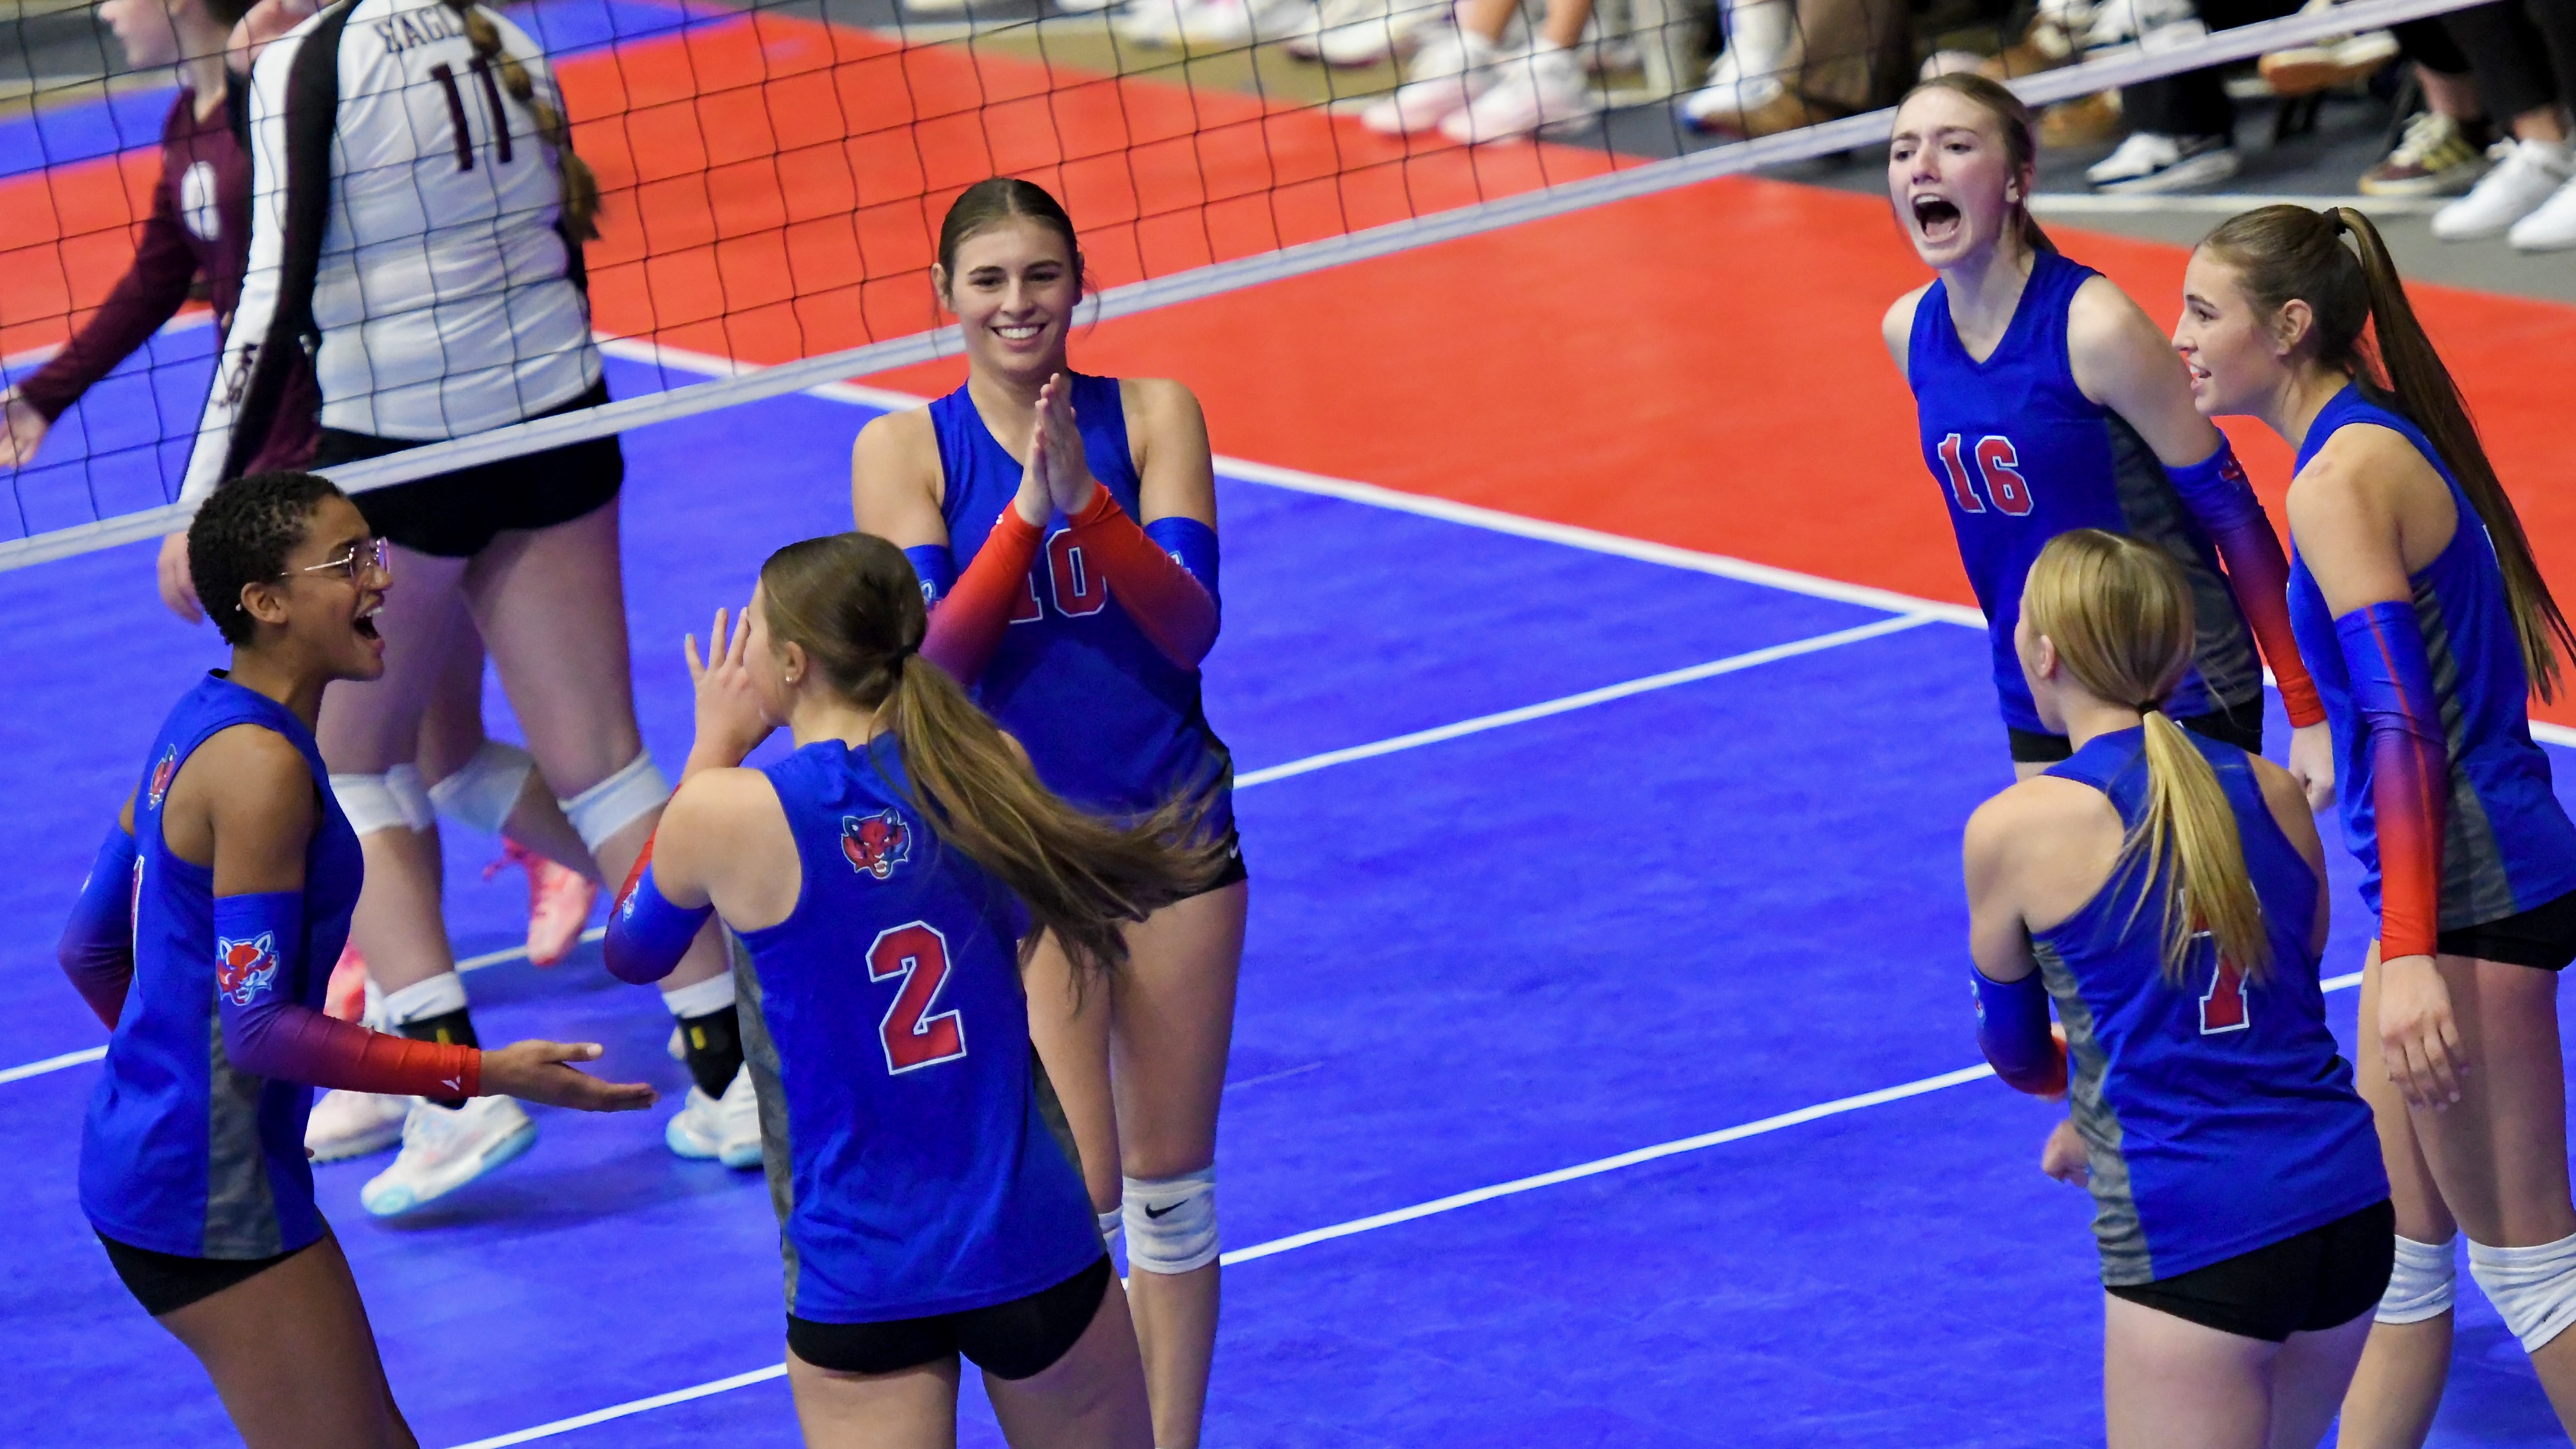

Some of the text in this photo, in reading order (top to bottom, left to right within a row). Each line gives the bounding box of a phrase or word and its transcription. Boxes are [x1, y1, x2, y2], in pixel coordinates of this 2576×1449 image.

[429, 56, 512, 172] 11
[1937, 433, 2034, 516] 16
[865, 920, 967, 1076] 2
